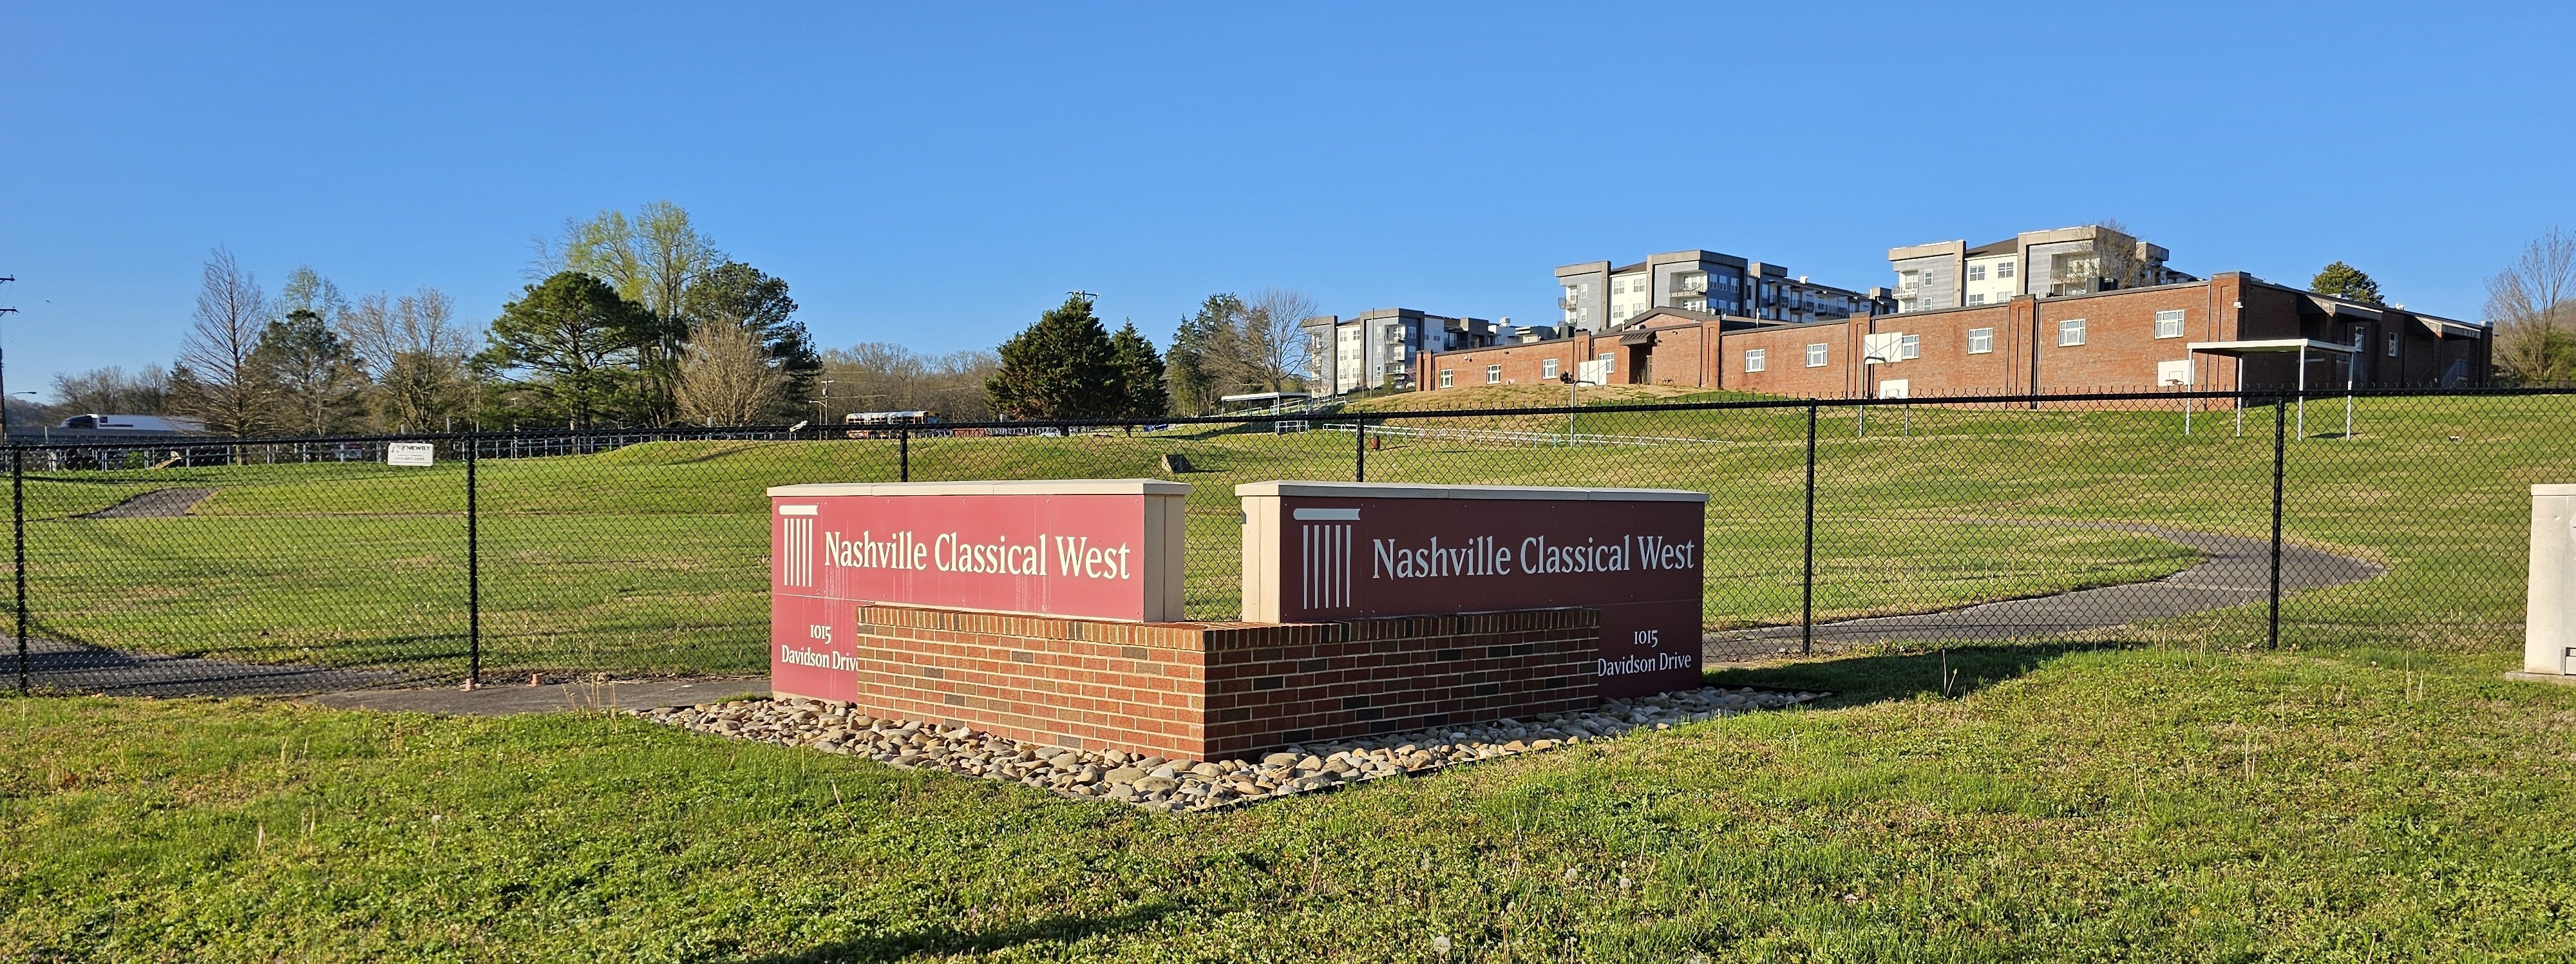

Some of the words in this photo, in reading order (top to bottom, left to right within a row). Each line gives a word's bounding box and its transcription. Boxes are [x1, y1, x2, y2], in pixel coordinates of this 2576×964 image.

[824, 531, 927, 571] Nashville
[934, 532, 1047, 576] Classical
[1054, 536, 1131, 580] West
[1372, 536, 1511, 580] Nashville
[1520, 534, 1630, 574] Classical
[1638, 536, 1695, 571] West
[810, 624, 832, 645] 1015
[1634, 629, 1658, 648] 1015
[781, 644, 830, 669] Davidson
[1598, 654, 1656, 677] Davidson
[1659, 652, 1692, 671] Drive
